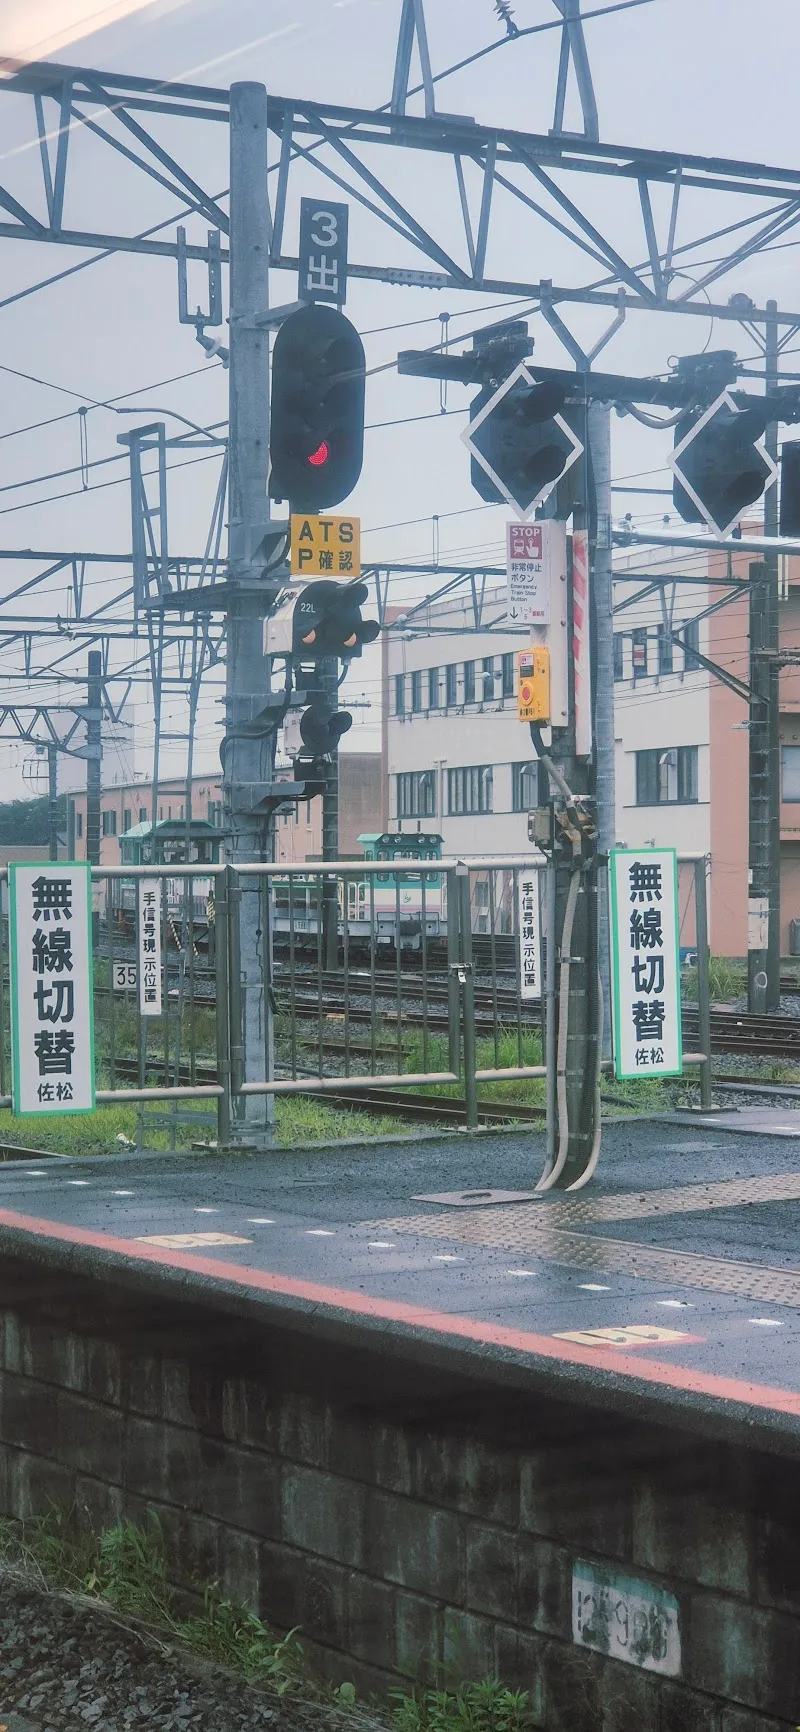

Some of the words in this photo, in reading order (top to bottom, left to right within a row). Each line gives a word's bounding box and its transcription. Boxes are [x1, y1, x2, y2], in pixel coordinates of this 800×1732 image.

[299, 521, 353, 543] ATS
[512, 527, 540, 536] STOP
[511, 562, 542, 572] 非常停止
[511, 573, 534, 582] ボタン
[301, 602, 316, 613] 22L
[522, 882, 536, 987] 手信号現示位置
[143, 891, 157, 1003] 手信号現示位置
[628, 861, 666, 1042] 無線切替
[31, 875, 75, 1076] 無線切替
[117, 967, 136, 985] 35
[635, 1047, 664, 1066] 佐松
[37, 1082, 74, 1102] 佐松
